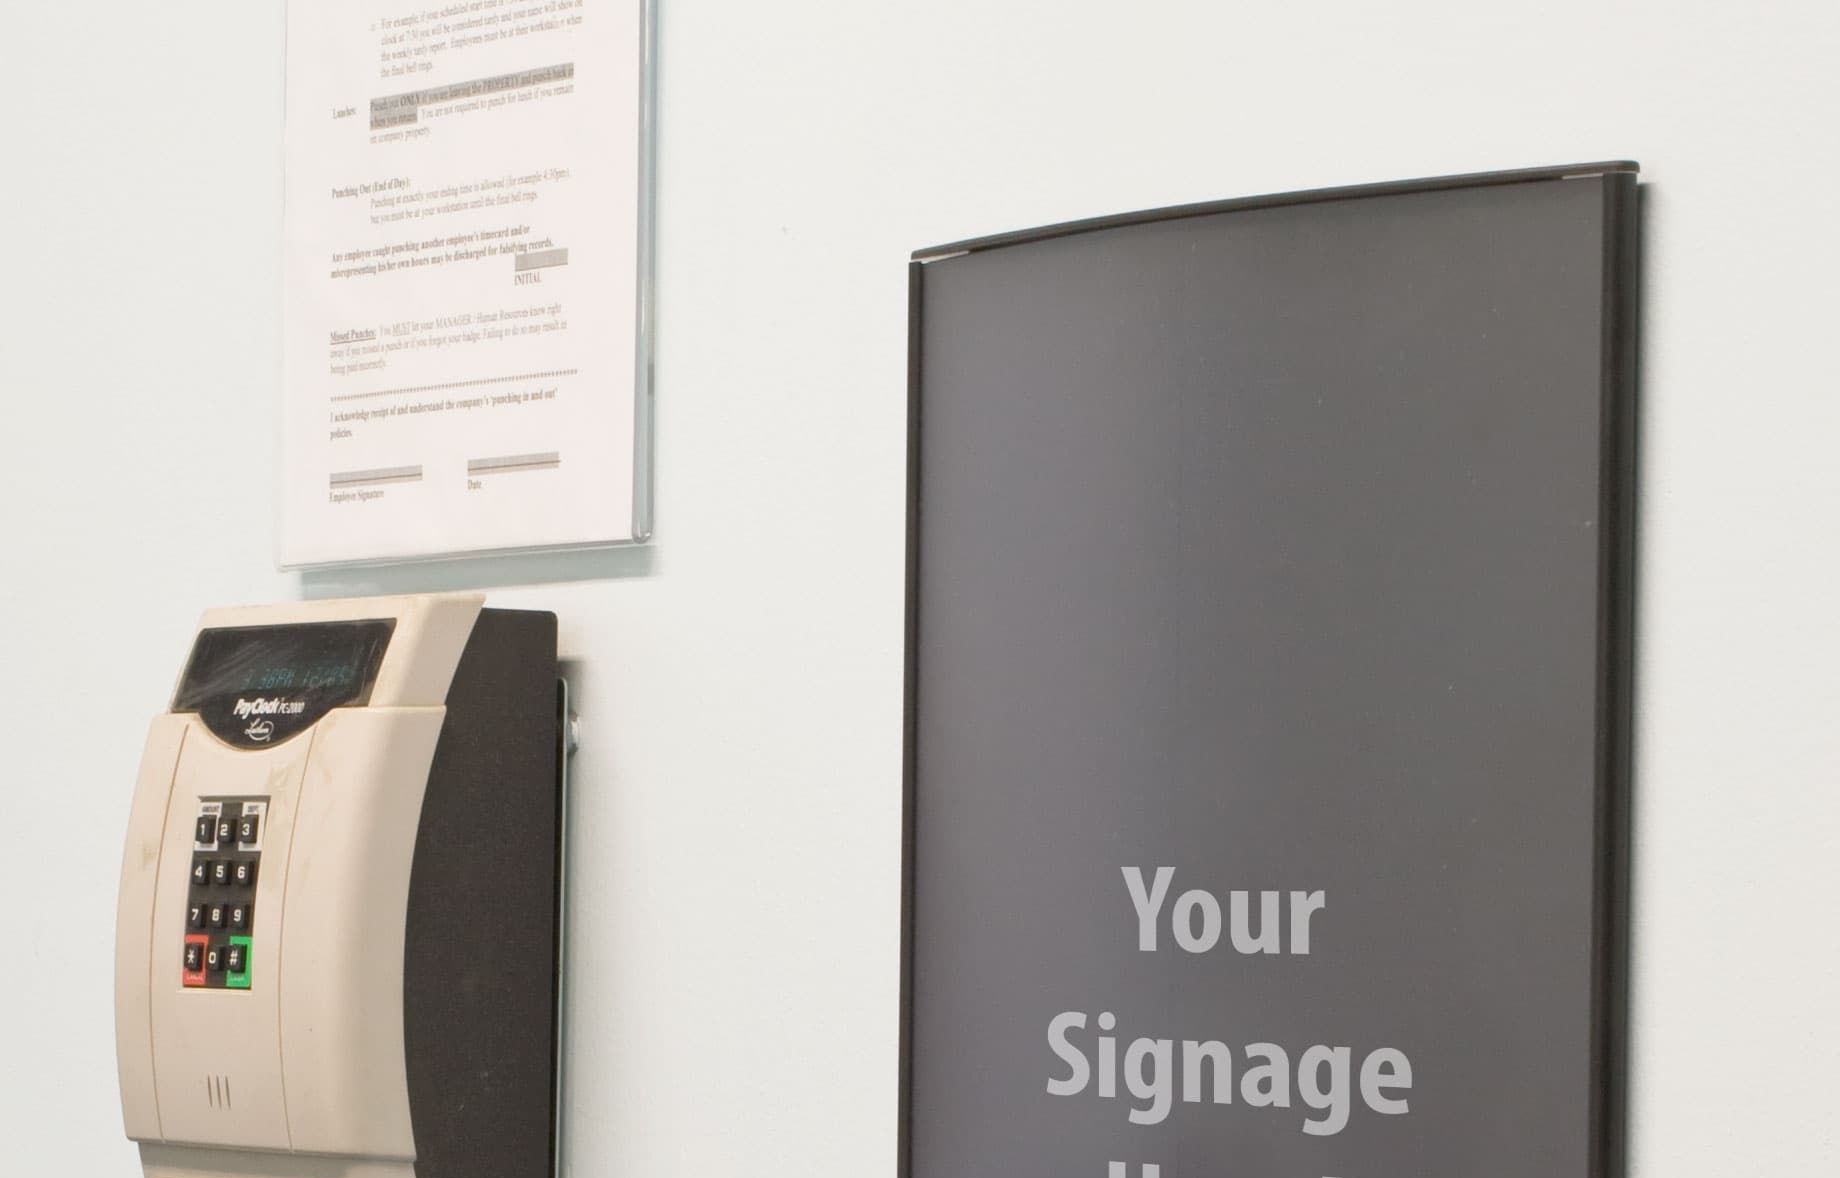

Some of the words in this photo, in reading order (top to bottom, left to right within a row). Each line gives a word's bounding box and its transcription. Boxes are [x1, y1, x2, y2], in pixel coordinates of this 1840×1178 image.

[200, 824, 205, 836] 1
[220, 824, 228, 836] 2
[242, 823, 250, 836] 3
[194, 865, 203, 878] 4
[216, 865, 224, 878] 5
[237, 866, 246, 879] 6
[191, 908, 199, 921] 7
[212, 908, 220, 921] 8
[233, 909, 241, 922] 9
[1120, 866, 1326, 955] Your
[208, 951, 217, 964] 0
[1046, 1011, 1413, 1136] Signage
